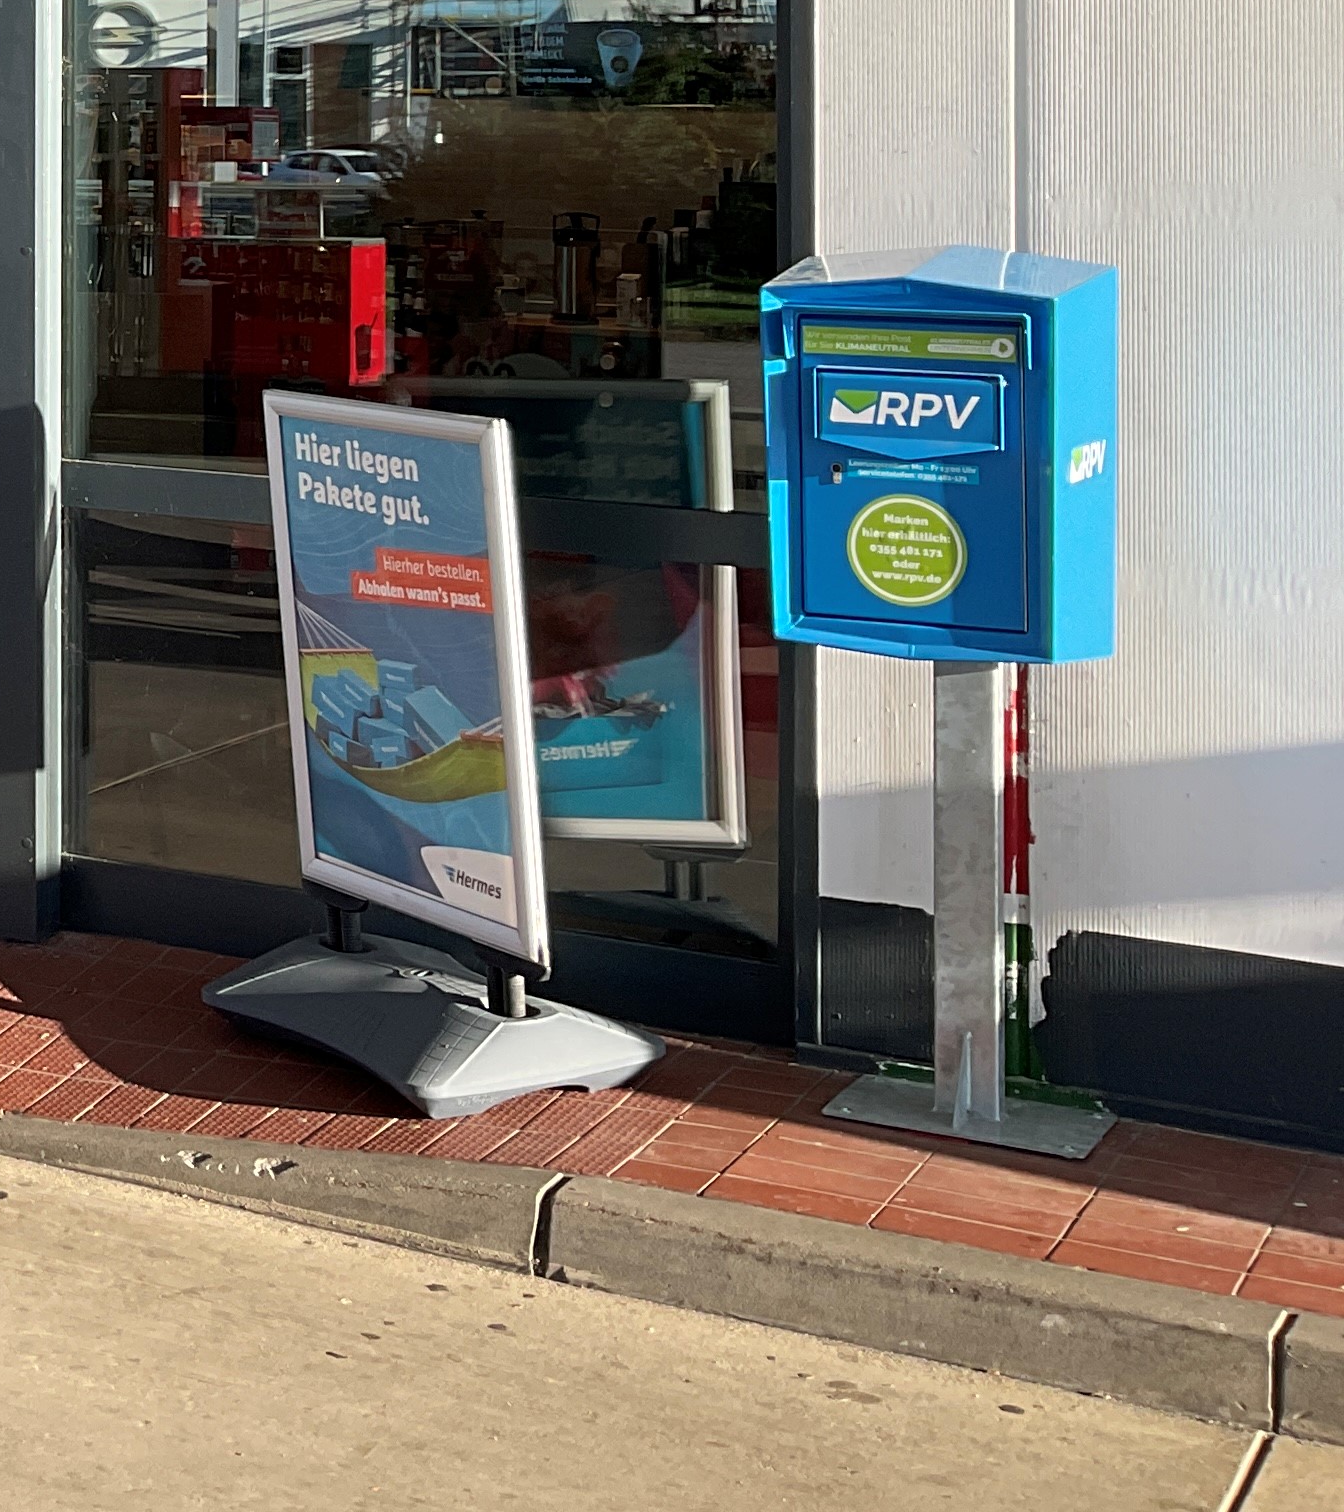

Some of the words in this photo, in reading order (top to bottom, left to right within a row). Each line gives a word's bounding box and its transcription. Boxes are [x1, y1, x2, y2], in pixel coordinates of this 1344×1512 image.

[835, 342, 912, 353] KLIMANEUTRAL
[876, 391, 981, 430] RPV
[294, 432, 341, 467] Hier
[345, 439, 419, 484] liegen
[1082, 439, 1107, 479] RPV
[298, 471, 377, 514] Pakete
[381, 494, 430, 526] gut.
[862, 526, 886, 538] hier
[883, 513, 929, 526] Marken
[869, 543, 898, 555] 0355
[899, 545, 921, 556] 481
[922, 548, 943, 558] 171
[892, 559, 920, 570] oder
[382, 554, 424, 576] Hierher
[426, 559, 484, 583] bestellen.
[872, 570, 942, 584] www.rpv.de
[358, 578, 405, 599] Abholen
[450, 591, 486, 609] passt.
[456, 869, 502, 900] Hermes
